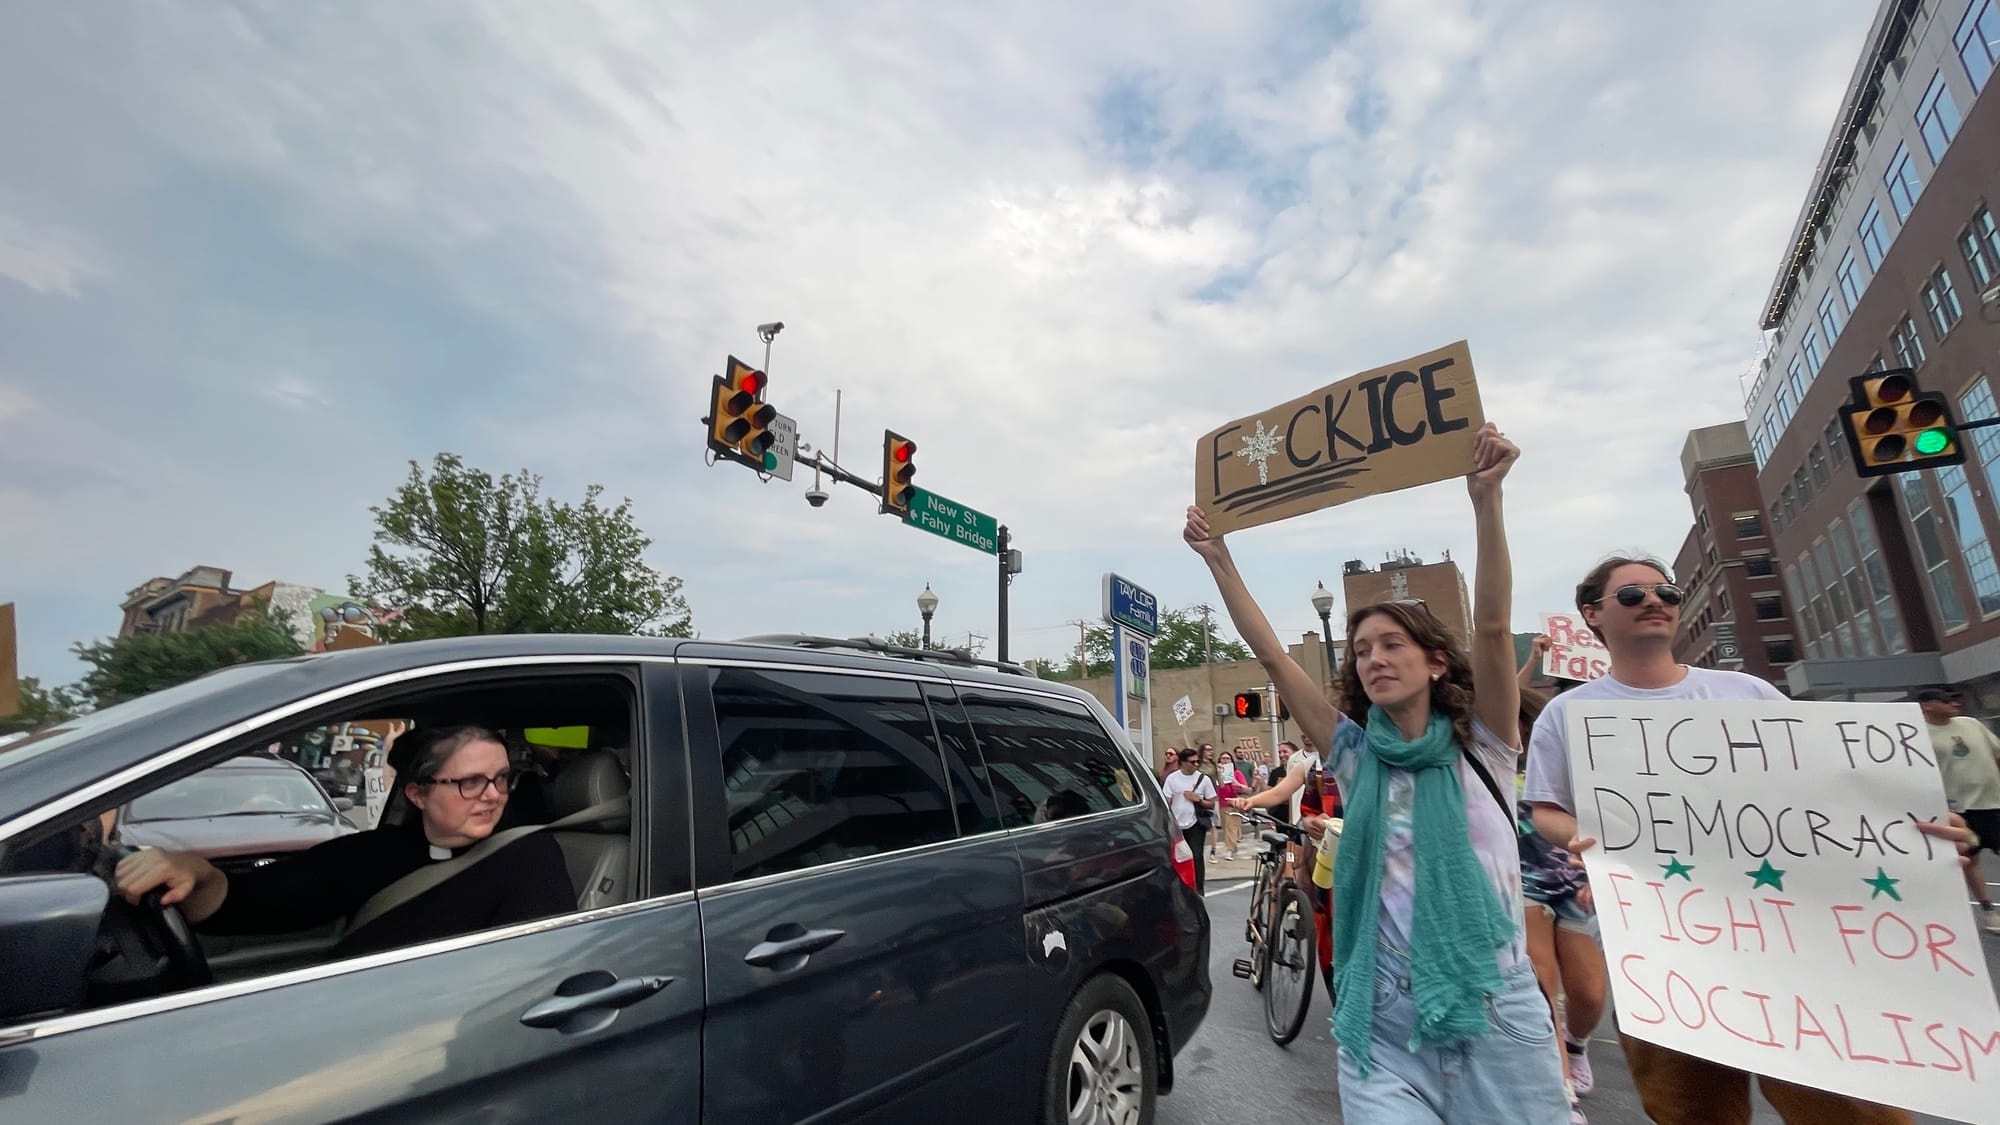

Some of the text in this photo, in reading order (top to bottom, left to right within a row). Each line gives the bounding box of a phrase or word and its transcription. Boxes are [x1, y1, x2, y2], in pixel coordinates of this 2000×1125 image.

[1358, 357, 1470, 455] ICE
[775, 420, 792, 433] TURN
[770, 444, 789, 457] REEN
[927, 495, 977, 527] New St
[921, 511, 993, 550] Fahy Bridge
[1117, 580, 1154, 610] TAYLOR
[1547, 615, 1607, 650] Re
[1549, 644, 1612, 680] Fas
[1240, 737, 1260, 749] ICE
[1583, 716, 1935, 776] FIGHT FOR
[1594, 787, 1938, 861] DEMOCRACY
[1608, 873, 1975, 977] FIGHT FOR
[1620, 954, 2000, 1082] SOCIALISM
